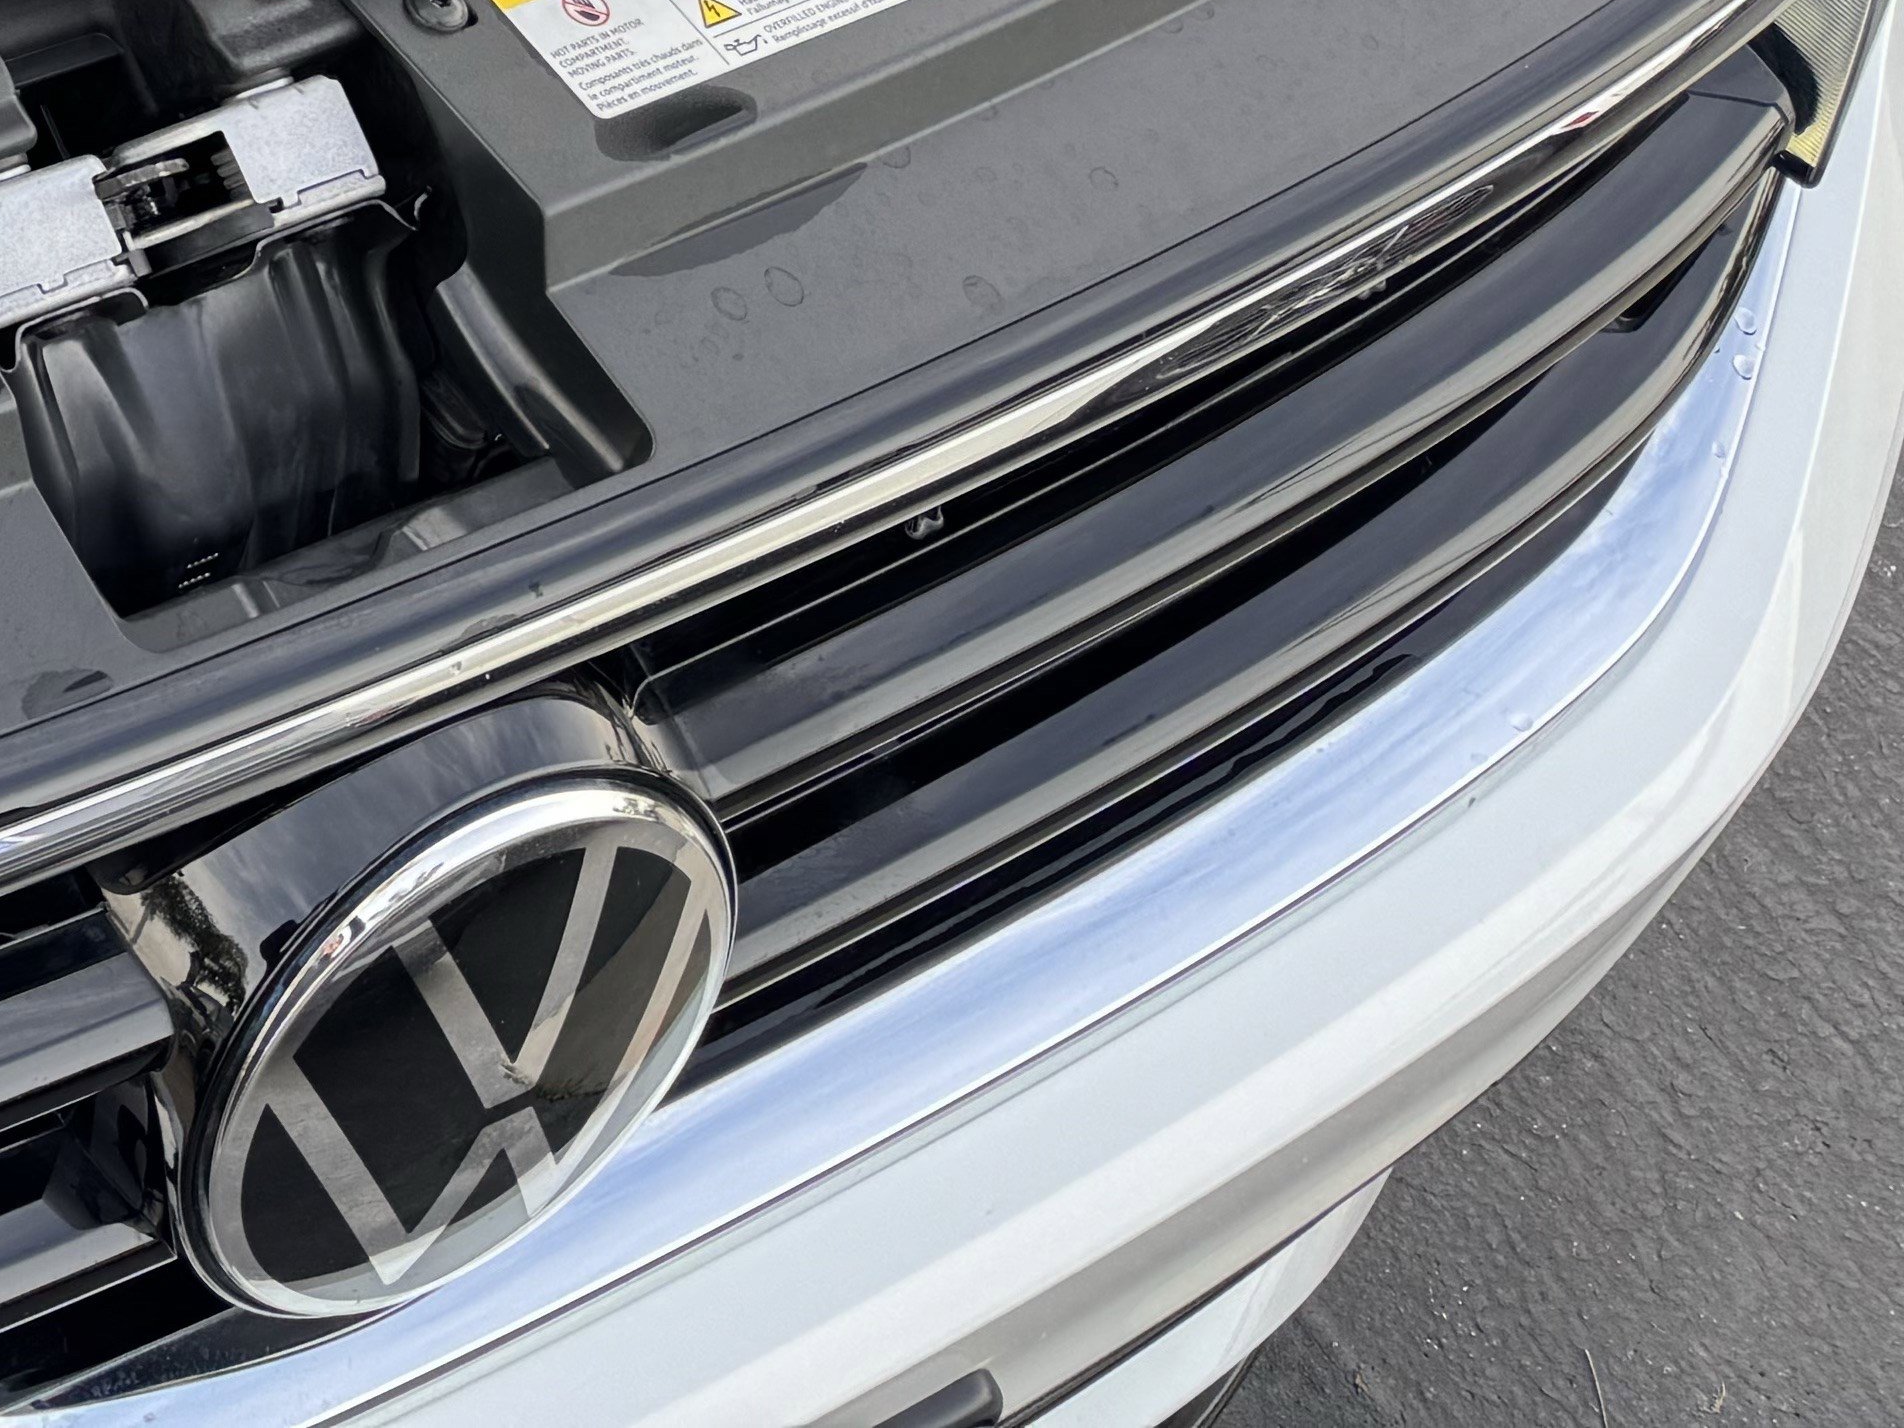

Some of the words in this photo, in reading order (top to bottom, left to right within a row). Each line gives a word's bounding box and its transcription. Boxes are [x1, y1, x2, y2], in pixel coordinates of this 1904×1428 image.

[762, 6, 816, 33] OVERFILLED
[770, 17, 827, 43] Remplissage
[549, 44, 570, 59] HOT
[568, 34, 600, 51] PARTS
[597, 29, 611, 40] IN
[608, 17, 644, 35] MOTOR
[566, 57, 606, 78] MOVING
[577, 65, 633, 91] Composants
[630, 58, 651, 70] très
[649, 46, 682, 64] chauds
[680, 38, 703, 51] dans
[586, 92, 599, 101] le
[598, 66, 663, 97] compartiment
[662, 54, 699, 72] moteur.
[595, 95, 628, 112] Pièces
[626, 90, 641, 100] en
[227, 824, 722, 1294] VW
